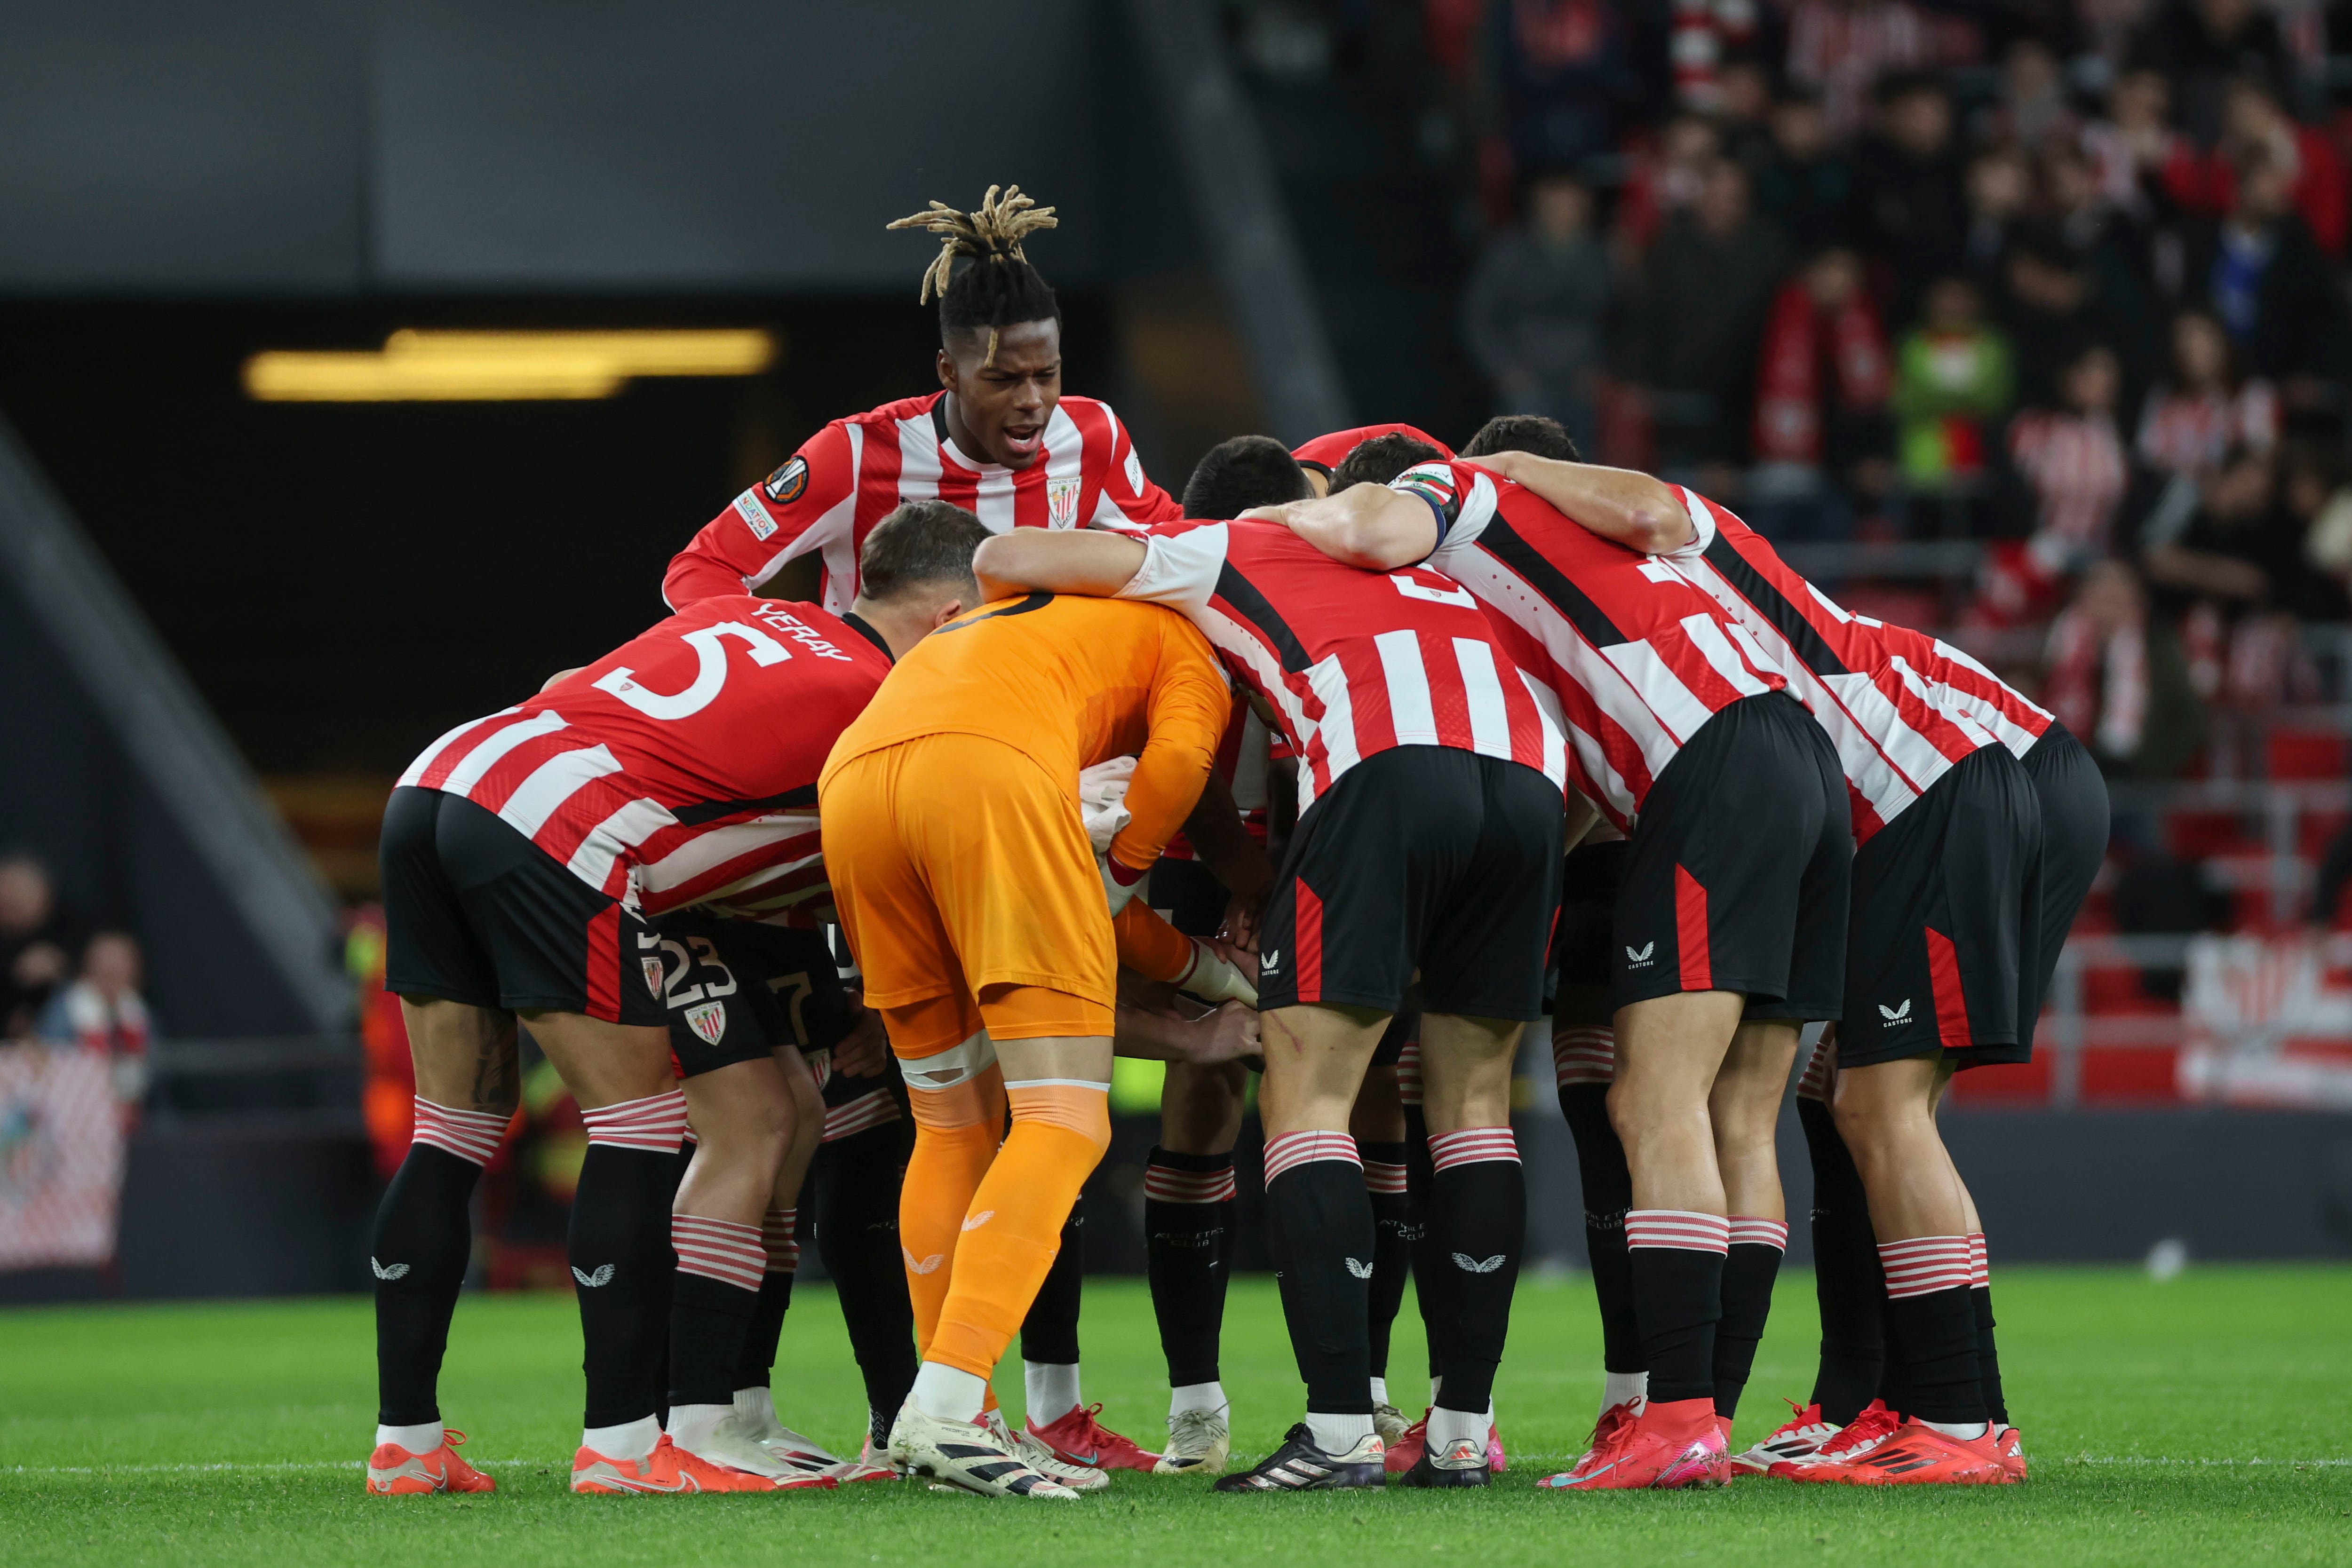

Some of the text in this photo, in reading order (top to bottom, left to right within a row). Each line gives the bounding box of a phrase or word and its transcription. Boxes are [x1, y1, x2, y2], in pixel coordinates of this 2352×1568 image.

[751, 602, 852, 662] YERAY
[591, 620, 793, 720] 5
[659, 936, 737, 1009] 23
[1628, 960, 1654, 969] CASTORE
[767, 971, 813, 1046] 7
[1883, 1017, 1913, 1028] CASTORE
[1588, 1219, 1622, 1229] CLUB
